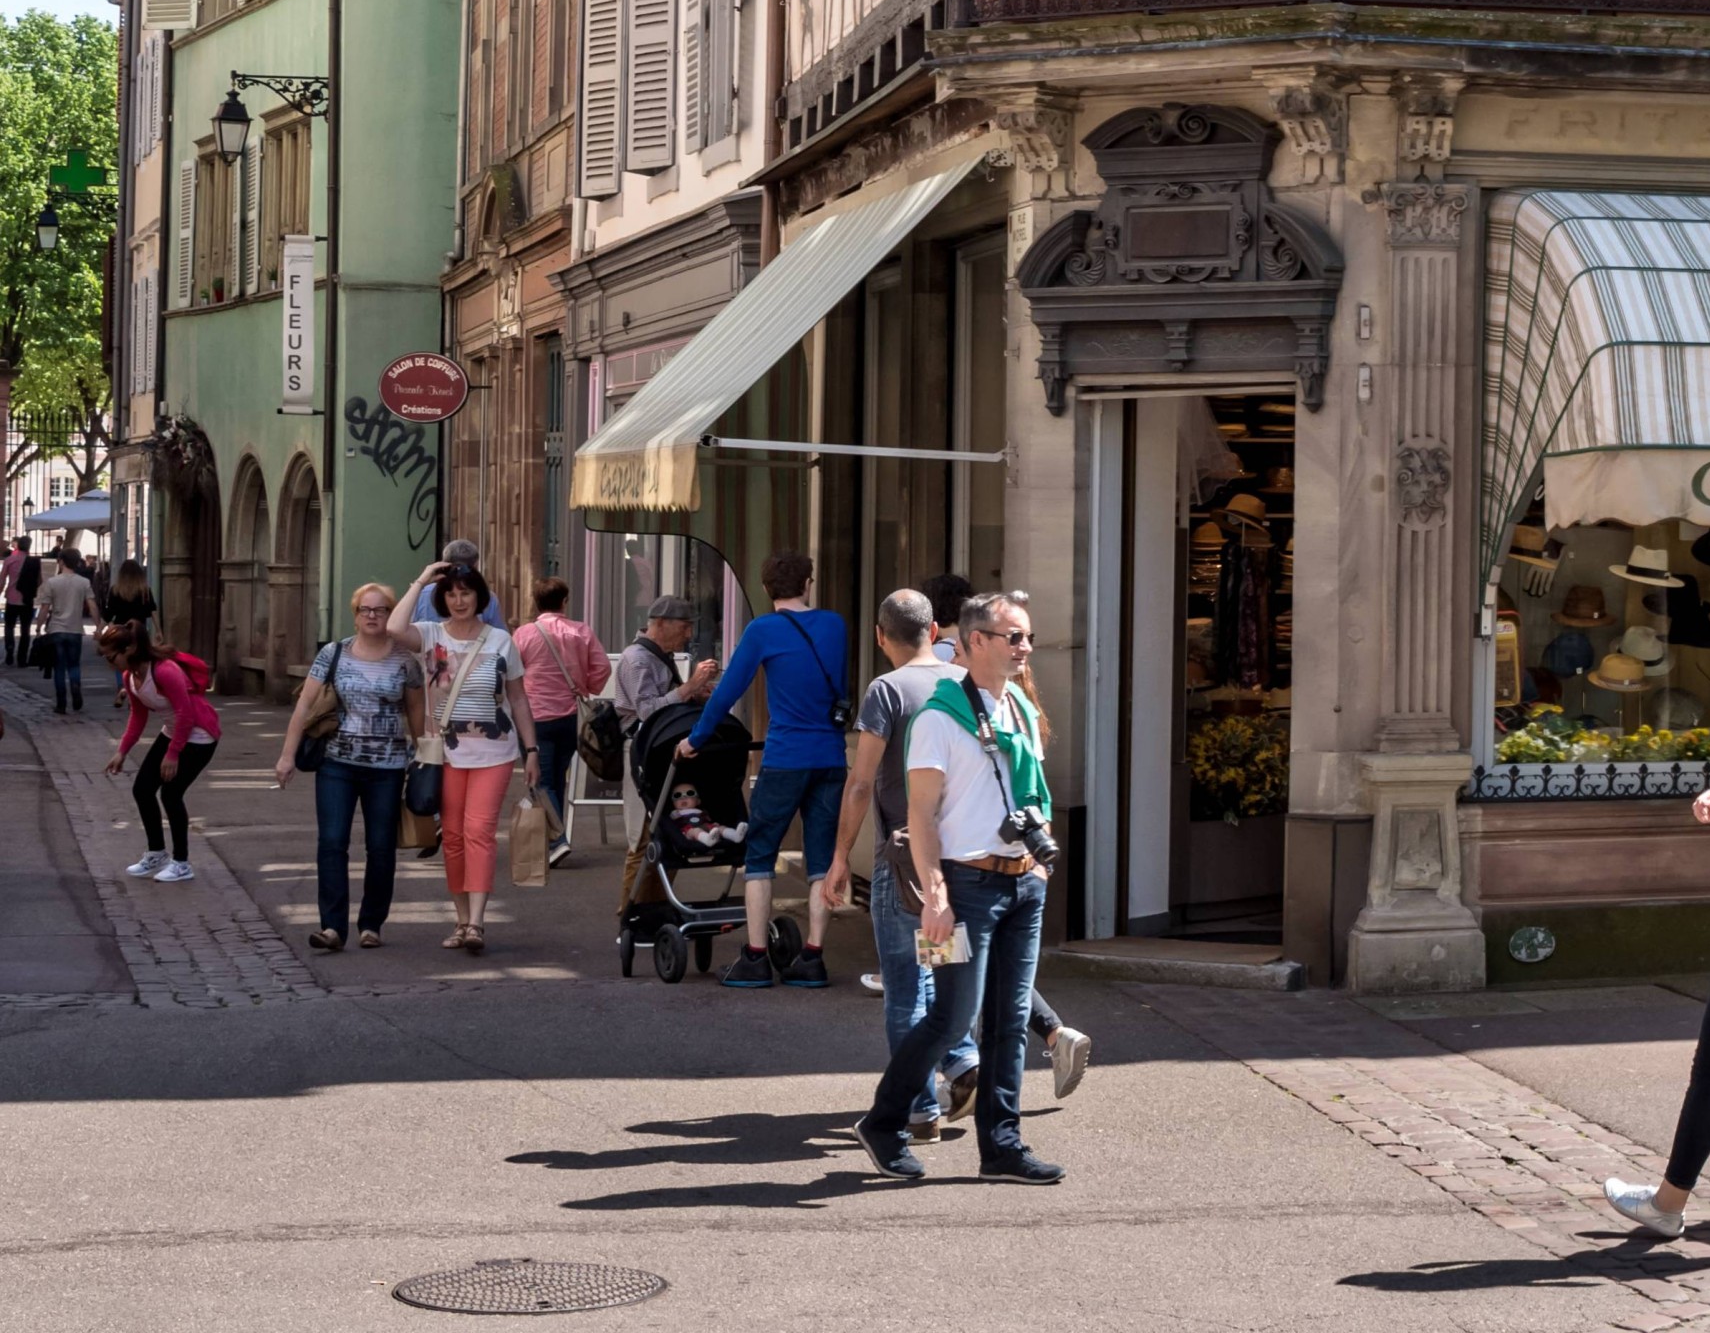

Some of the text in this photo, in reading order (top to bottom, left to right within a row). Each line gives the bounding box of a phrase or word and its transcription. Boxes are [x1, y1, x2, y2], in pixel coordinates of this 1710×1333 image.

[287, 274, 302, 392] FLEURS
[388, 357, 460, 382] SALON DE COIFFURE
[401, 404, 442, 415] Créations
